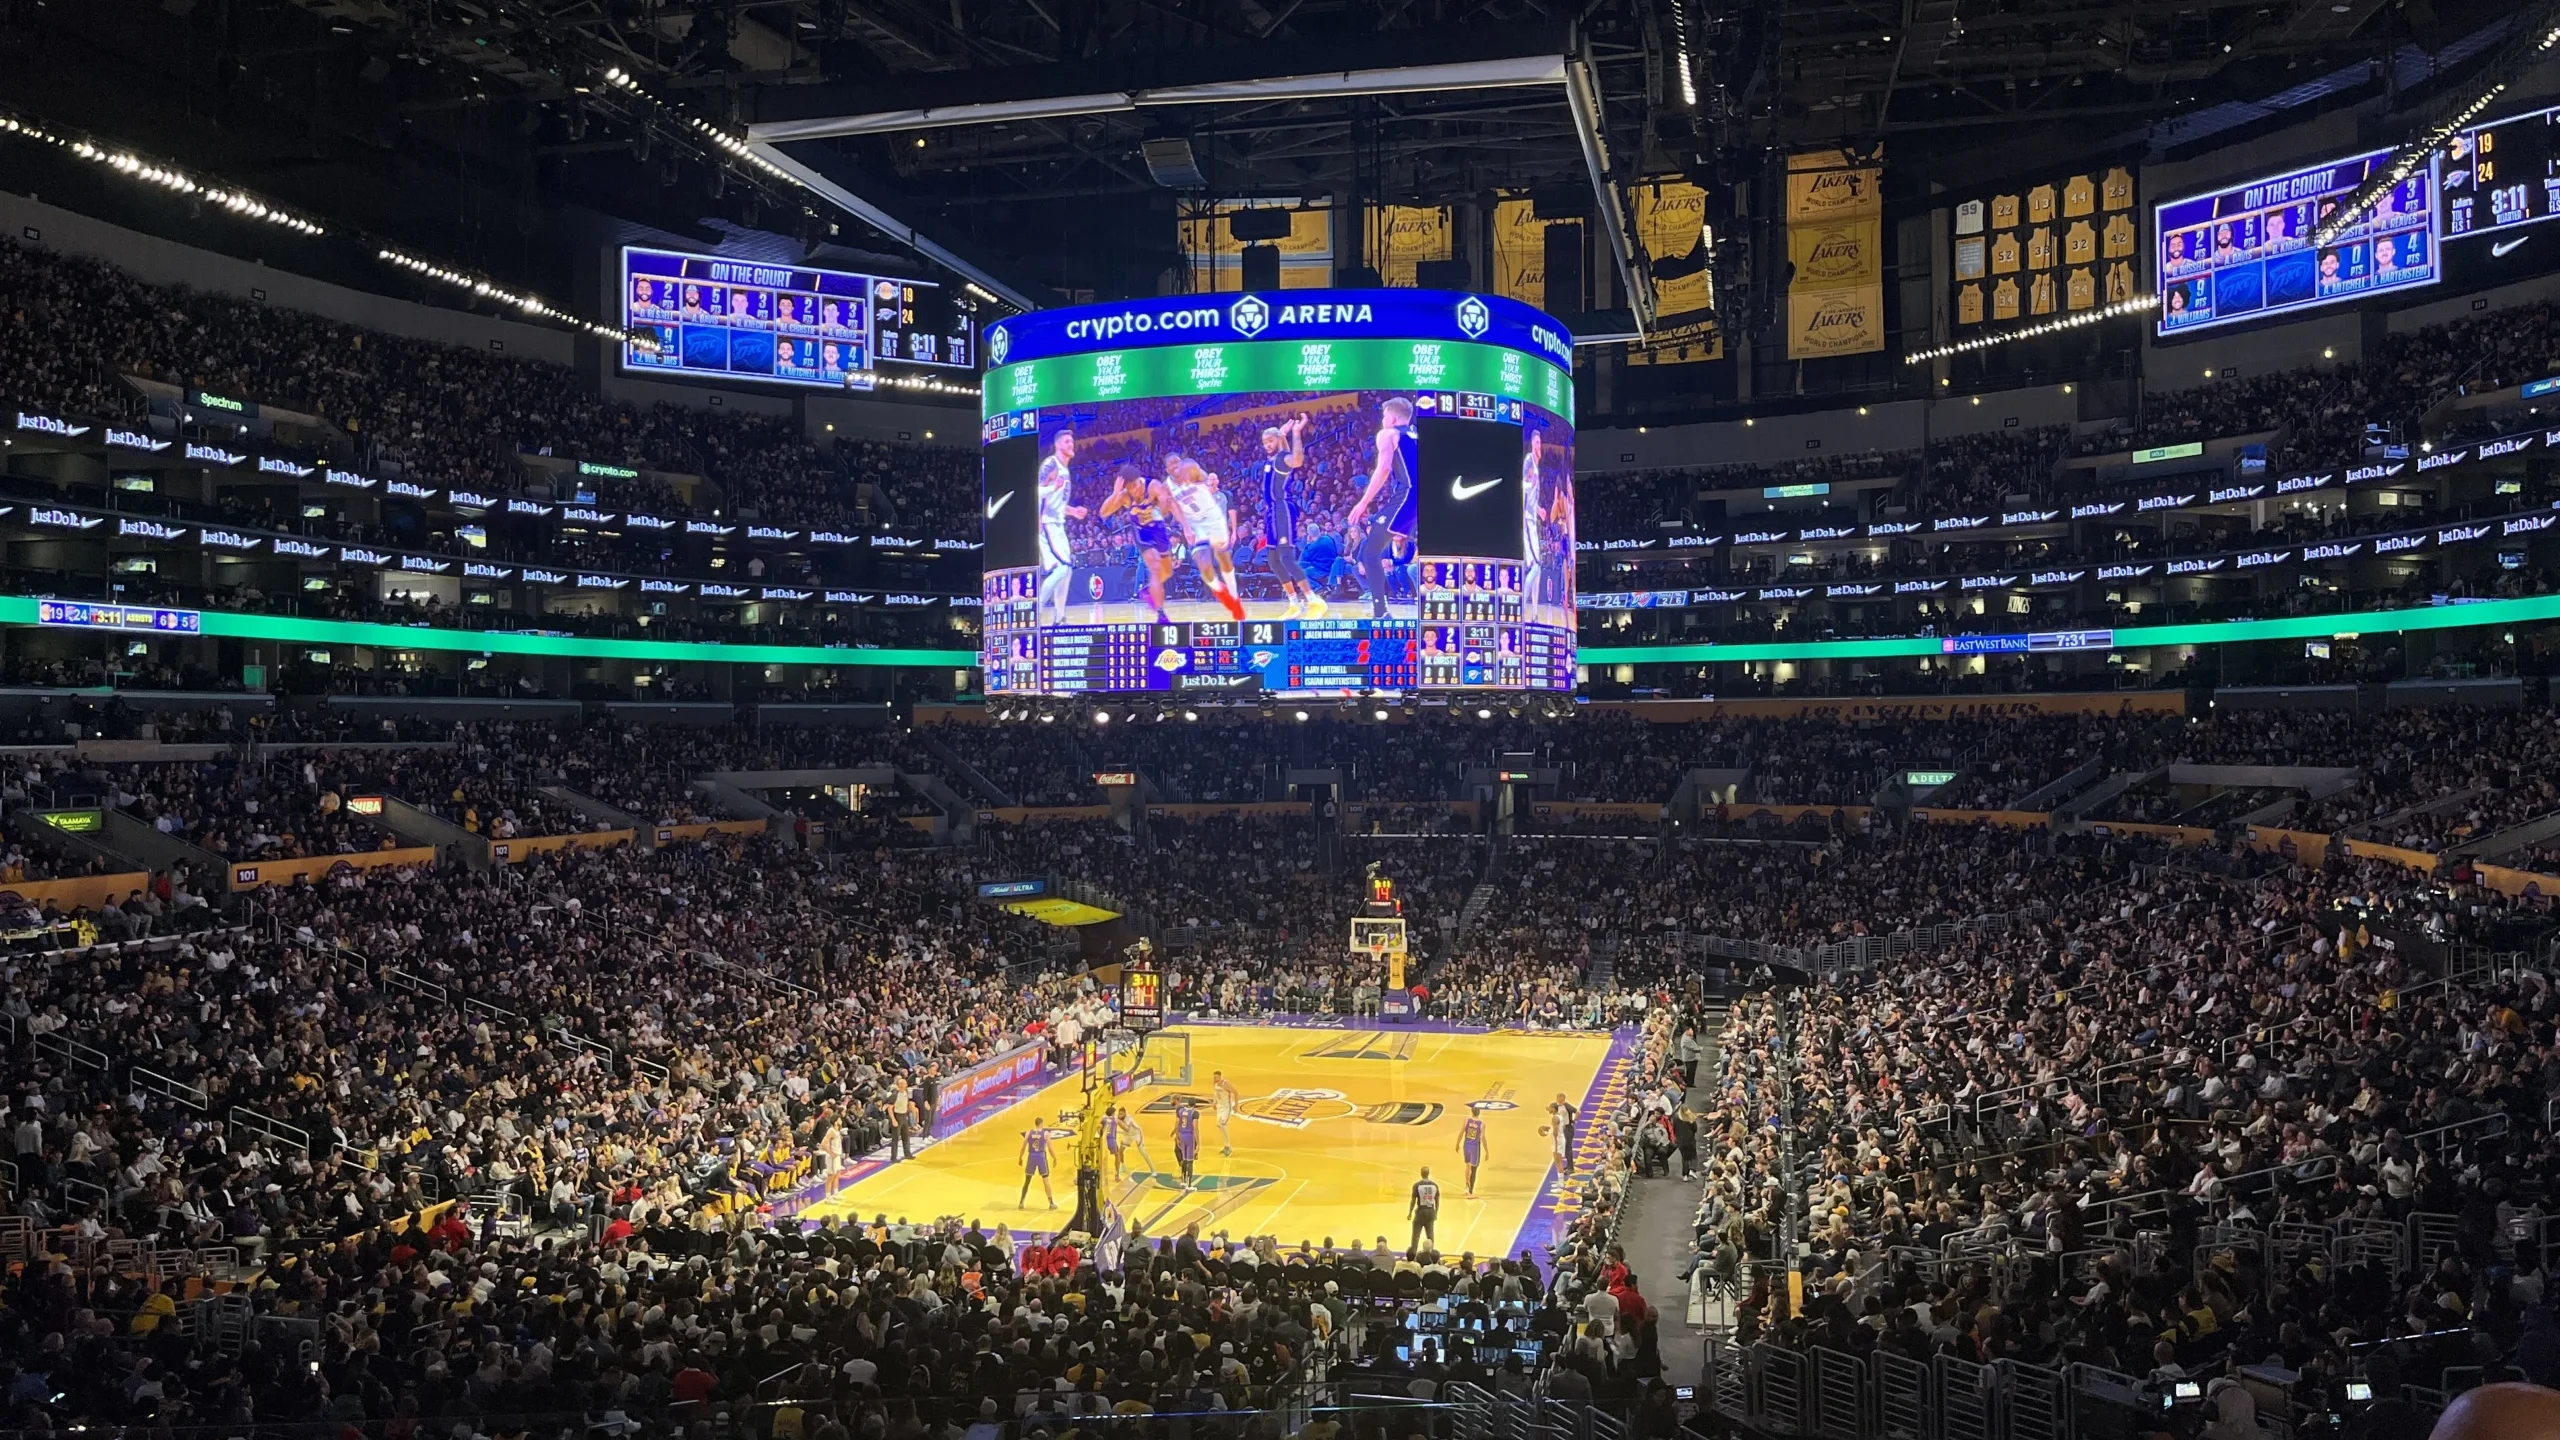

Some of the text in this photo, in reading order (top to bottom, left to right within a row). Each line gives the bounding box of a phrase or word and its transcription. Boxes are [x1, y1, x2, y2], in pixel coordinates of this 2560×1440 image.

[2478, 133, 2492, 153] 19
[2479, 162, 2493, 182] 24
[2109, 186, 2127, 197] 25
[2244, 169, 2335, 209] ON THE COURT
[2407, 182, 2415, 199] 3
[2035, 200, 2049, 210] 13
[2071, 192, 2087, 204] 44
[2492, 184, 2526, 215] 3:11
[1650, 198, 1703, 215] LAKERS
[1962, 205, 1977, 216] 99
[1998, 205, 2012, 216] 22
[2297, 207, 2305, 224] 3
[2452, 208, 2471, 221] TOL 6
[2497, 209, 2529, 224] QUARTER 1
[1385, 221, 1434, 235] LAKERS
[2245, 219, 2253, 235] 5
[2381, 216, 2417, 231] A. REAVES
[2452, 220, 2470, 233] FLS 1
[2111, 233, 2126, 243] 42
[2196, 231, 2204, 247] 2
[2408, 234, 2417, 251] 4
[1402, 239, 1436, 253] CHAMPIONS
[2035, 246, 2050, 255] 33
[2073, 240, 2088, 251] 32
[1809, 243, 1860, 263] LAKERS
[1999, 251, 2014, 262] 52
[2232, 251, 2252, 263] DAVIS
[2352, 247, 2360, 264] 0
[712, 263, 792, 287] ON THE COURT
[1806, 260, 1863, 278] WORLD CHAMPIONS
[1669, 275, 1705, 292] CHAMPIONS
[2197, 280, 2204, 296] 9
[2323, 278, 2365, 295] A. MITCHELL
[664, 284, 672, 298] 2
[712, 289, 720, 303] 5
[903, 288, 913, 302] 19
[2041, 290, 2047, 300] 8
[2074, 285, 2088, 297] 24
[759, 293, 767, 308] 3
[805, 299, 812, 313] 2
[1999, 295, 2012, 307] 34
[849, 304, 856, 318] 3
[902, 309, 913, 324] 24
[2171, 309, 2210, 325] J. WILLIAMS
[1067, 305, 1373, 339] crypto.com ARENA
[1808, 311, 1865, 331] LAKERS
[911, 333, 935, 353] 3:11
[1804, 329, 1868, 348] WORLD CHAMPIONS
[805, 342, 812, 356] 0
[849, 346, 856, 360] 4
[1195, 348, 1223, 359] OBEY
[1302, 344, 1330, 356] OBEY
[1412, 344, 1441, 356] OBEY
[1097, 355, 1122, 366] OBEY
[1197, 358, 1221, 368] YOUR
[1304, 354, 1330, 365] YOUR
[1414, 354, 1440, 365] YOUR
[1503, 352, 1519, 364] OBEY
[1098, 365, 1120, 376] YOUR
[1191, 367, 1228, 379] THIRST.
[1298, 364, 1336, 375] THIRST.
[1409, 364, 1446, 376] THIRST.
[1093, 374, 1126, 386] THIRST.
[1197, 378, 1221, 389] Sprite
[1304, 375, 1331, 385] Sprite
[1414, 375, 1440, 385] Sprite
[1098, 385, 1121, 396] Sprite
[201, 393, 242, 411] Spectrum
[1440, 395, 1520, 419] 19 3:11 24
[18, 412, 37, 429] Just
[38, 416, 55, 431] Do
[186, 443, 202, 458] Just
[203, 446, 218, 461] Do
[2479, 445, 2492, 460] Just
[2493, 443, 2506, 455] Do
[591, 466, 638, 478] crypto.com
[2346, 470, 2361, 483] Just
[2362, 467, 2376, 478] Do
[2210, 491, 2224, 503] Just
[2225, 488, 2239, 499] Do
[31, 508, 50, 524] Just
[51, 510, 68, 525] Do
[201, 529, 218, 544] Just
[219, 532, 233, 545] Do
[1446, 564, 1453, 578] 2
[1485, 565, 1490, 579] 5
[1026, 574, 1032, 587] 3
[2007, 596, 2030, 613] KINGS
[50, 607, 188, 628] 19 24 3:11 ASSISTS 6 5
[1163, 624, 1272, 645] 19 3:11 24
[1447, 628, 1454, 642] 2
[1471, 628, 1489, 636] 3:11
[1027, 635, 1033, 649] 3
[2057, 634, 2086, 647] 7:31
[1182, 675, 1227, 688] Just Do It.
[1800, 705, 1845, 717] LOS
[1951, 702, 2041, 716] LAKERS
[496, 846, 508, 856] 102
[239, 871, 256, 881] 101
[1376, 888, 1389, 900] 14
[1132, 974, 1157, 986] 3:11
